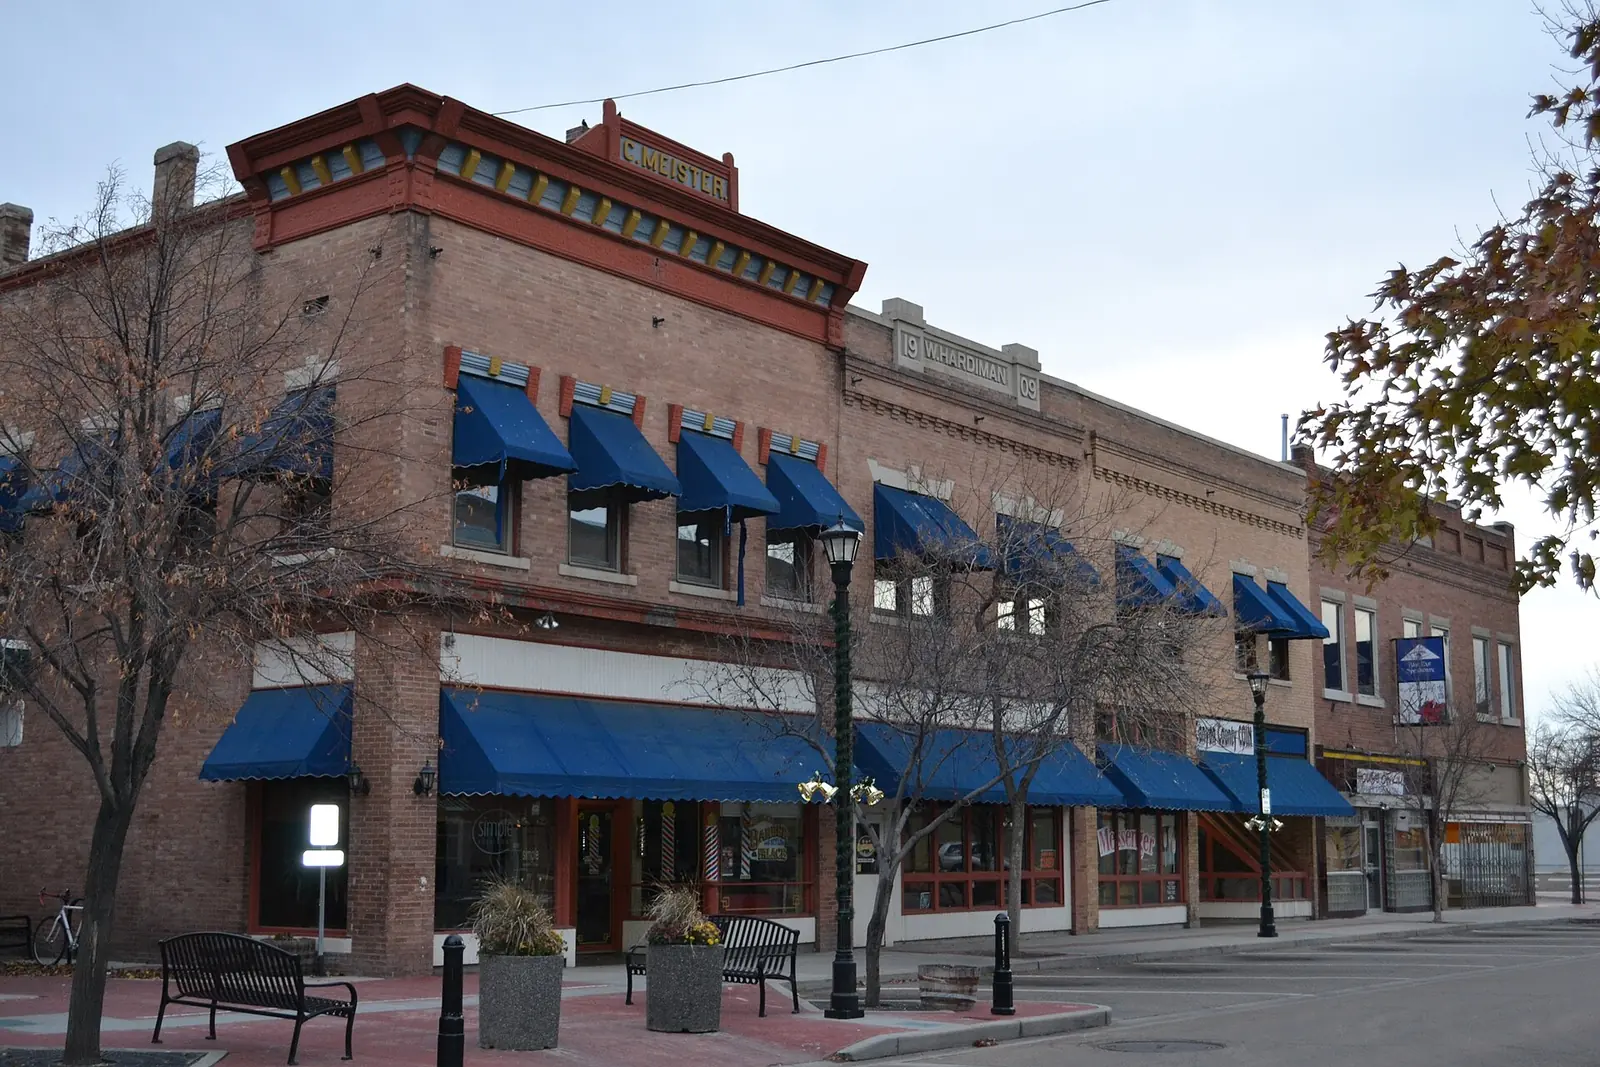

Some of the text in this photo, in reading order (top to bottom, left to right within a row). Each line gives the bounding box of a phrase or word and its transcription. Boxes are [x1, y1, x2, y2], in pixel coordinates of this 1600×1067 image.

[904, 333, 918, 360] 19
[1020, 375, 1037, 400] 09
[478, 817, 513, 841] simple
[1098, 828, 1156, 859] Mesener
